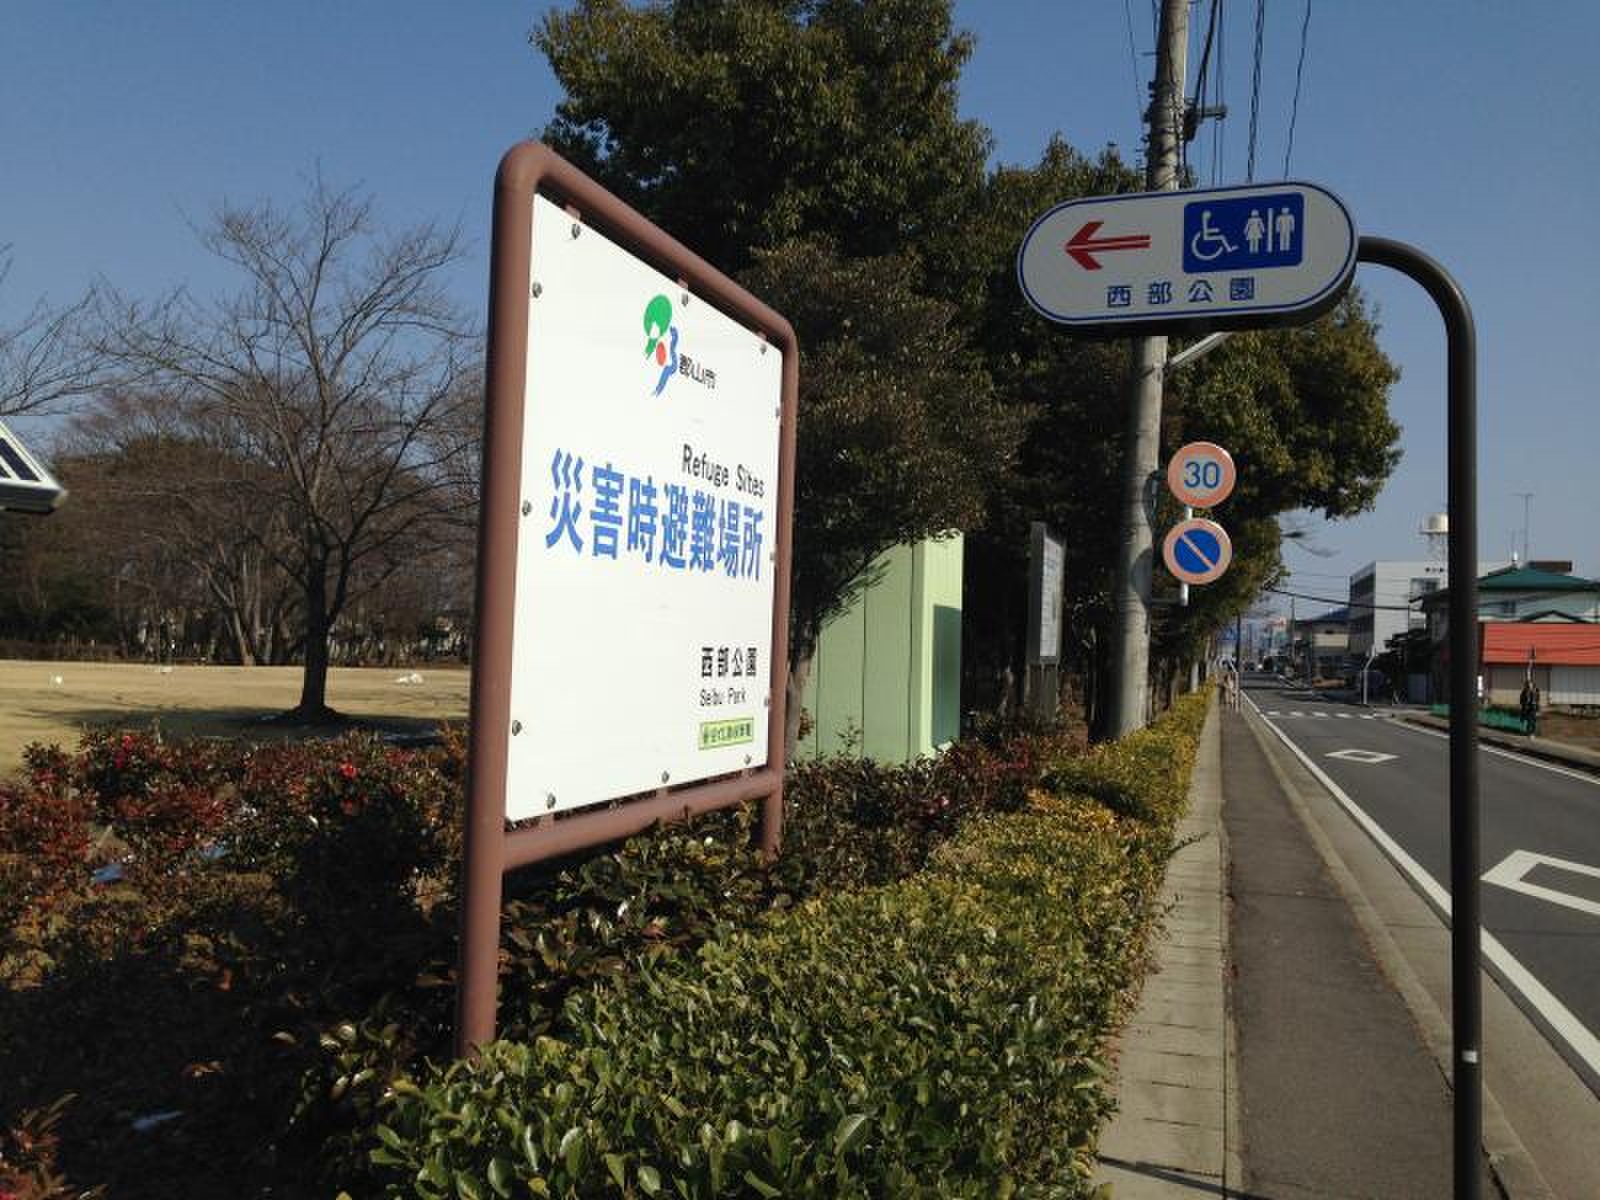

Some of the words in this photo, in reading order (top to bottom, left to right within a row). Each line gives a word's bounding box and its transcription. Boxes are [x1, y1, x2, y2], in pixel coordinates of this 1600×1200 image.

[1107, 277, 1255, 308] 西部公園
[679, 352, 716, 390] 郡山市
[682, 444, 729, 488] Refuge
[735, 464, 765, 499] Sites
[1184, 461, 1221, 489] 30
[545, 447, 764, 582] 災害時避難場所
[701, 646, 757, 678] 西部公園
[727, 687, 747, 705] Park
